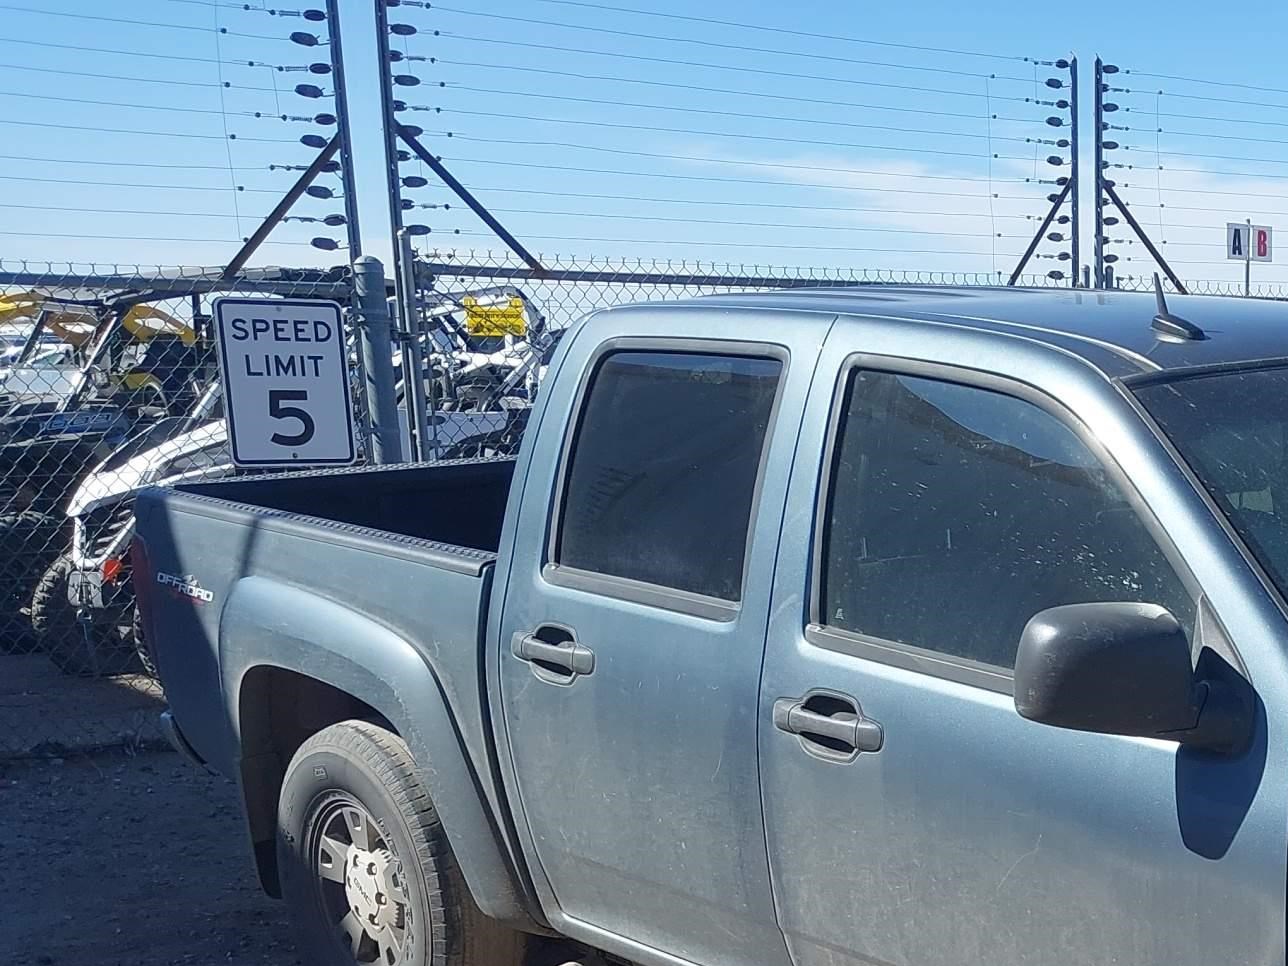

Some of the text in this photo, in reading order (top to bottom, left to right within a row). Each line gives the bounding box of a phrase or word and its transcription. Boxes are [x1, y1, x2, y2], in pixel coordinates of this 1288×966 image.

[1231, 228, 1268, 257] A B
[231, 318, 333, 343] SPEED
[244, 354, 324, 377] LIMIT
[268, 389, 316, 447] 5
[353, 876, 372, 907] GMC
